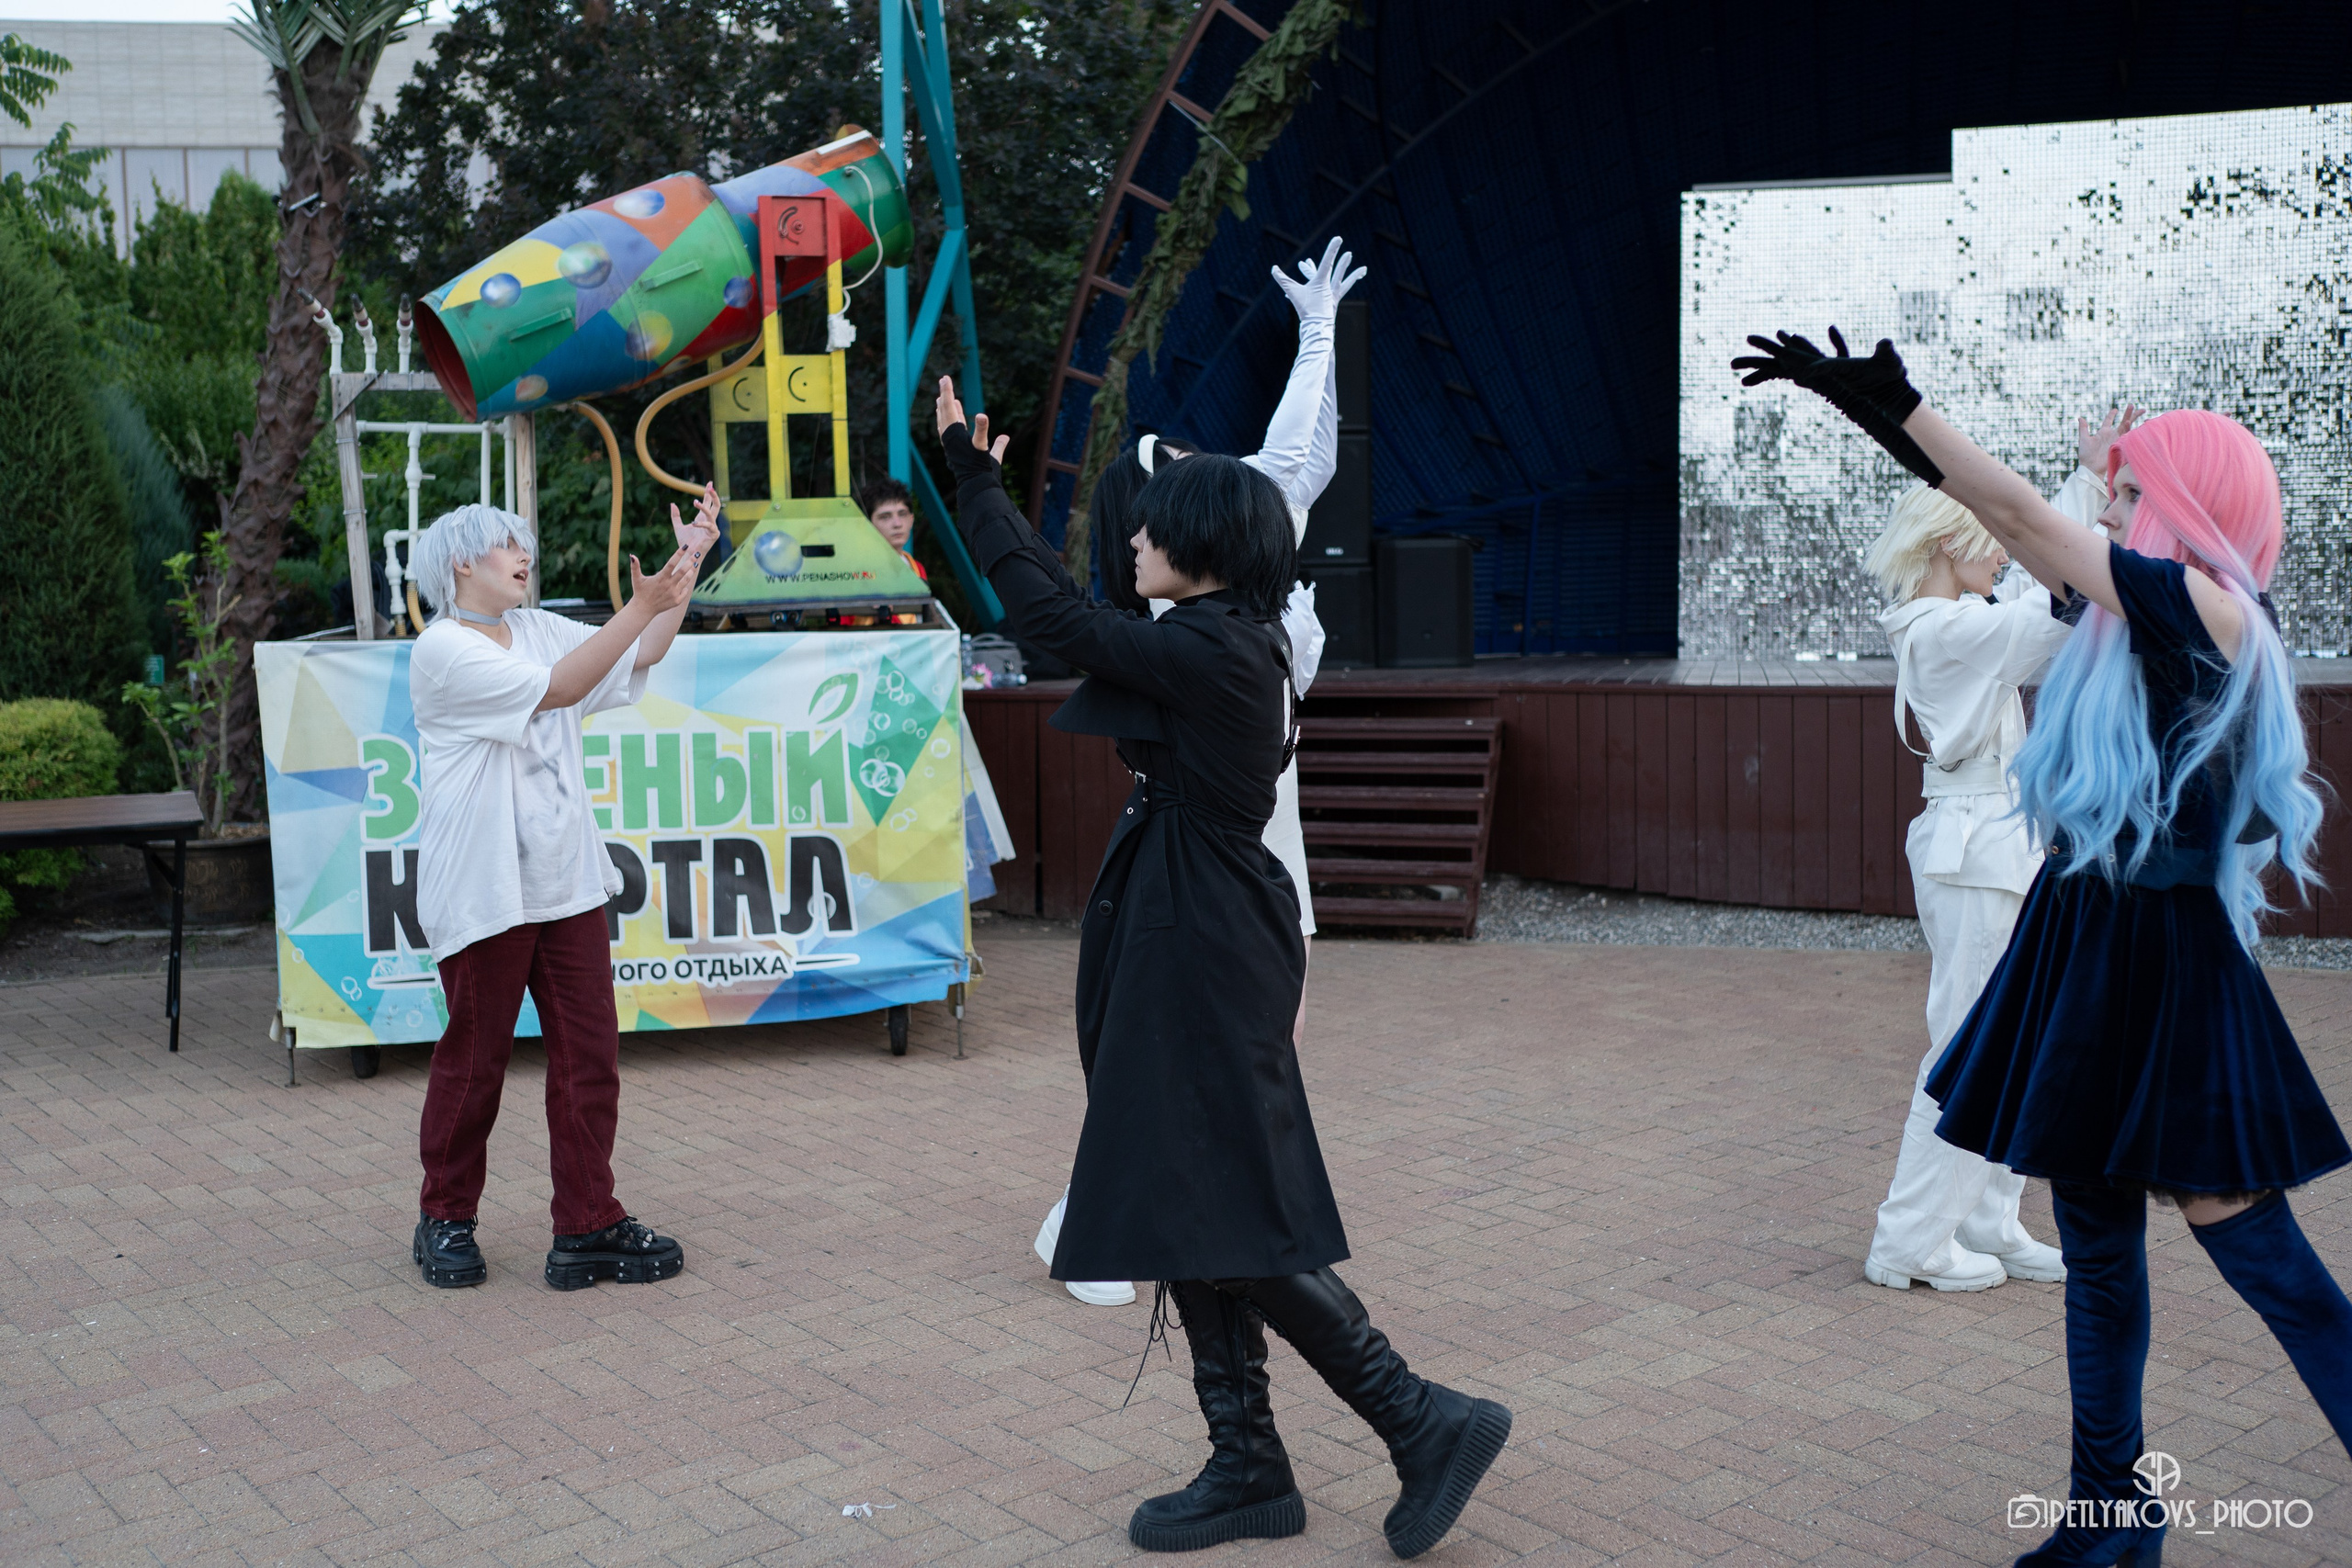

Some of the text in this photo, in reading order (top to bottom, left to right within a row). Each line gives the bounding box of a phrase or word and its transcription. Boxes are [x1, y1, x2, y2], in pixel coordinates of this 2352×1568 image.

[362, 673, 859, 840] ЗЕНЫЙ
[365, 836, 854, 953] КРТАЛ
[674, 955, 788, 982] ОТДЫХА
